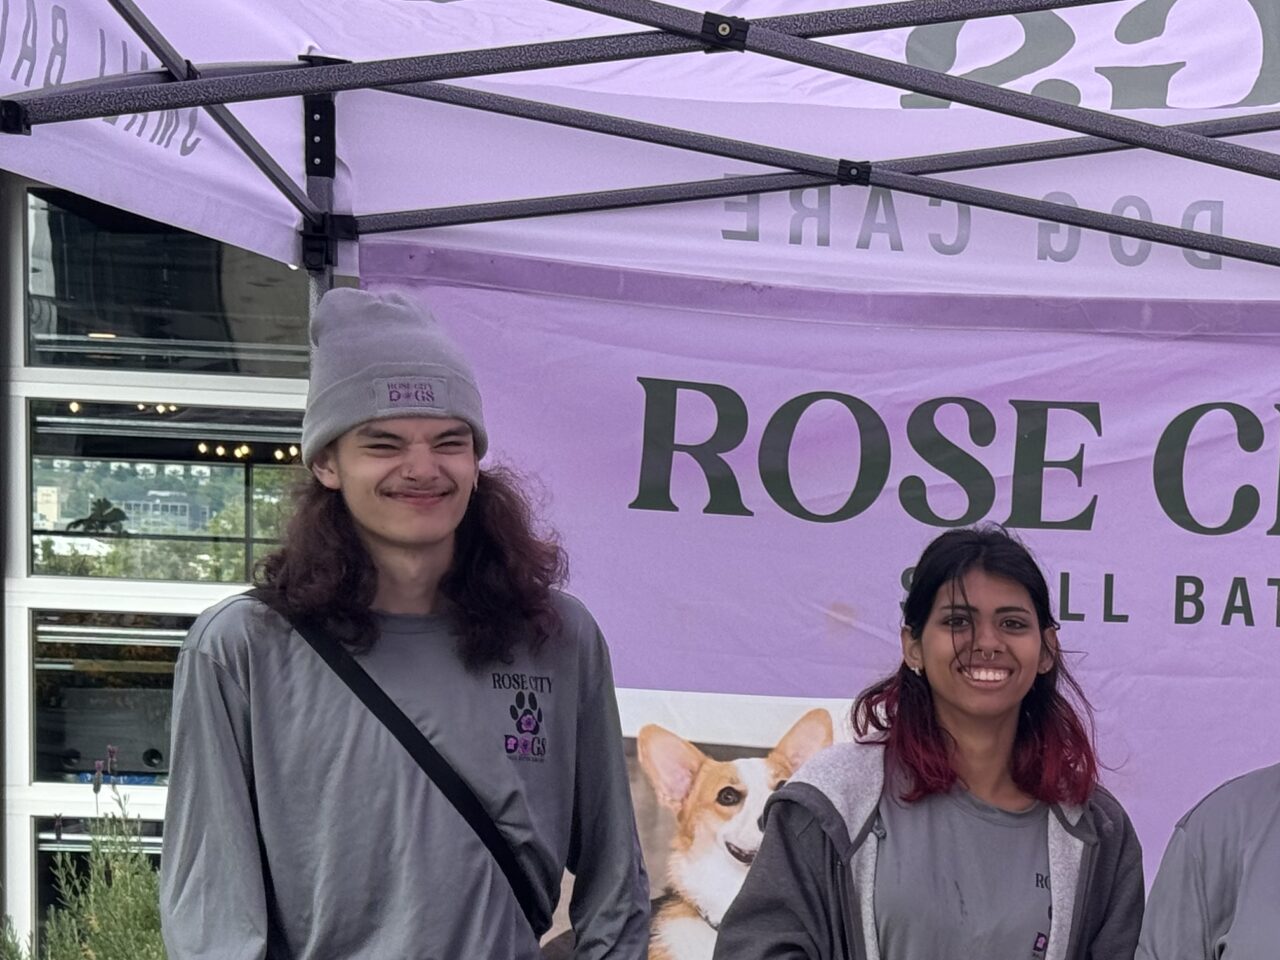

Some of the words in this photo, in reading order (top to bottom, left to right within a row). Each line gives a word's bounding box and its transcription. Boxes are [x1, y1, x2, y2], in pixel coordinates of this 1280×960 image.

[628, 376, 1102, 530] ROSE
[492, 672, 528, 690] ROSE
[529, 676, 553, 694] CITY
